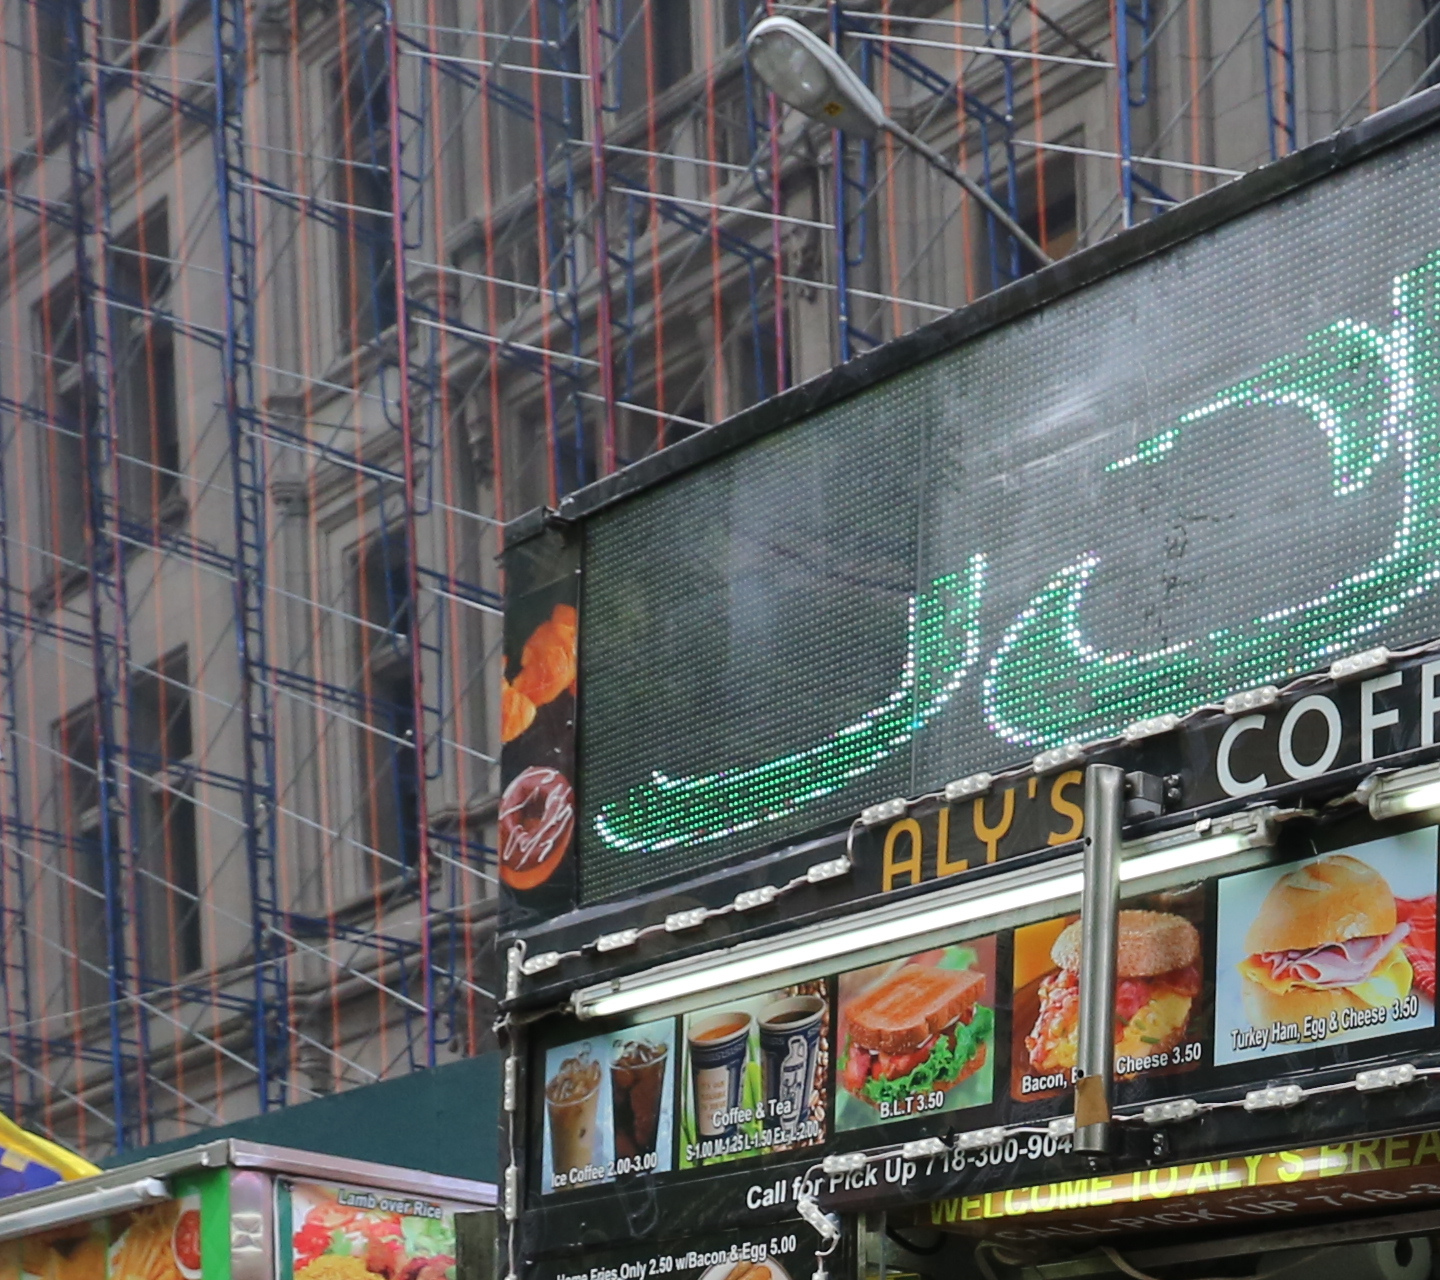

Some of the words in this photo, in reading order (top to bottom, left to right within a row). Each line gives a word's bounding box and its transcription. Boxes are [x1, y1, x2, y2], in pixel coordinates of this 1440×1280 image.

[881, 770, 1085, 891] ALY'S
[1230, 1026, 1269, 1051] Turkey
[1272, 1018, 1301, 1047] Ham,
[1303, 1013, 1325, 1041] Egg
[1327, 1010, 1340, 1031] &
[1341, 1004, 1387, 1030] Cheese
[1391, 996, 1418, 1020] 3.50
[713, 1106, 752, 1128] Coffee
[756, 1102, 765, 1118] &
[768, 1099, 792, 1116] Tea
[879, 1096, 913, 1121] B.L.T
[916, 1091, 944, 1113] 3.50
[551, 1173, 567, 1188] Ice
[569, 1164, 604, 1184] Coffee
[607, 1152, 658, 1177] 2.00-3.00
[931, 1177, 1113, 1225] WELCOME
[1132, 1166, 1179, 1202] TO
[1187, 1143, 1305, 1195] ALY'S
[337, 1189, 377, 1209] Lamb
[380, 1199, 411, 1212] over
[412, 1201, 443, 1219] Rice
[649, 1258, 673, 1275] 2.50
[675, 1250, 726, 1271] w/Bacon
[730, 1245, 740, 1261] &
[742, 1242, 768, 1264] Egg
[770, 1235, 796, 1256] 5.00
